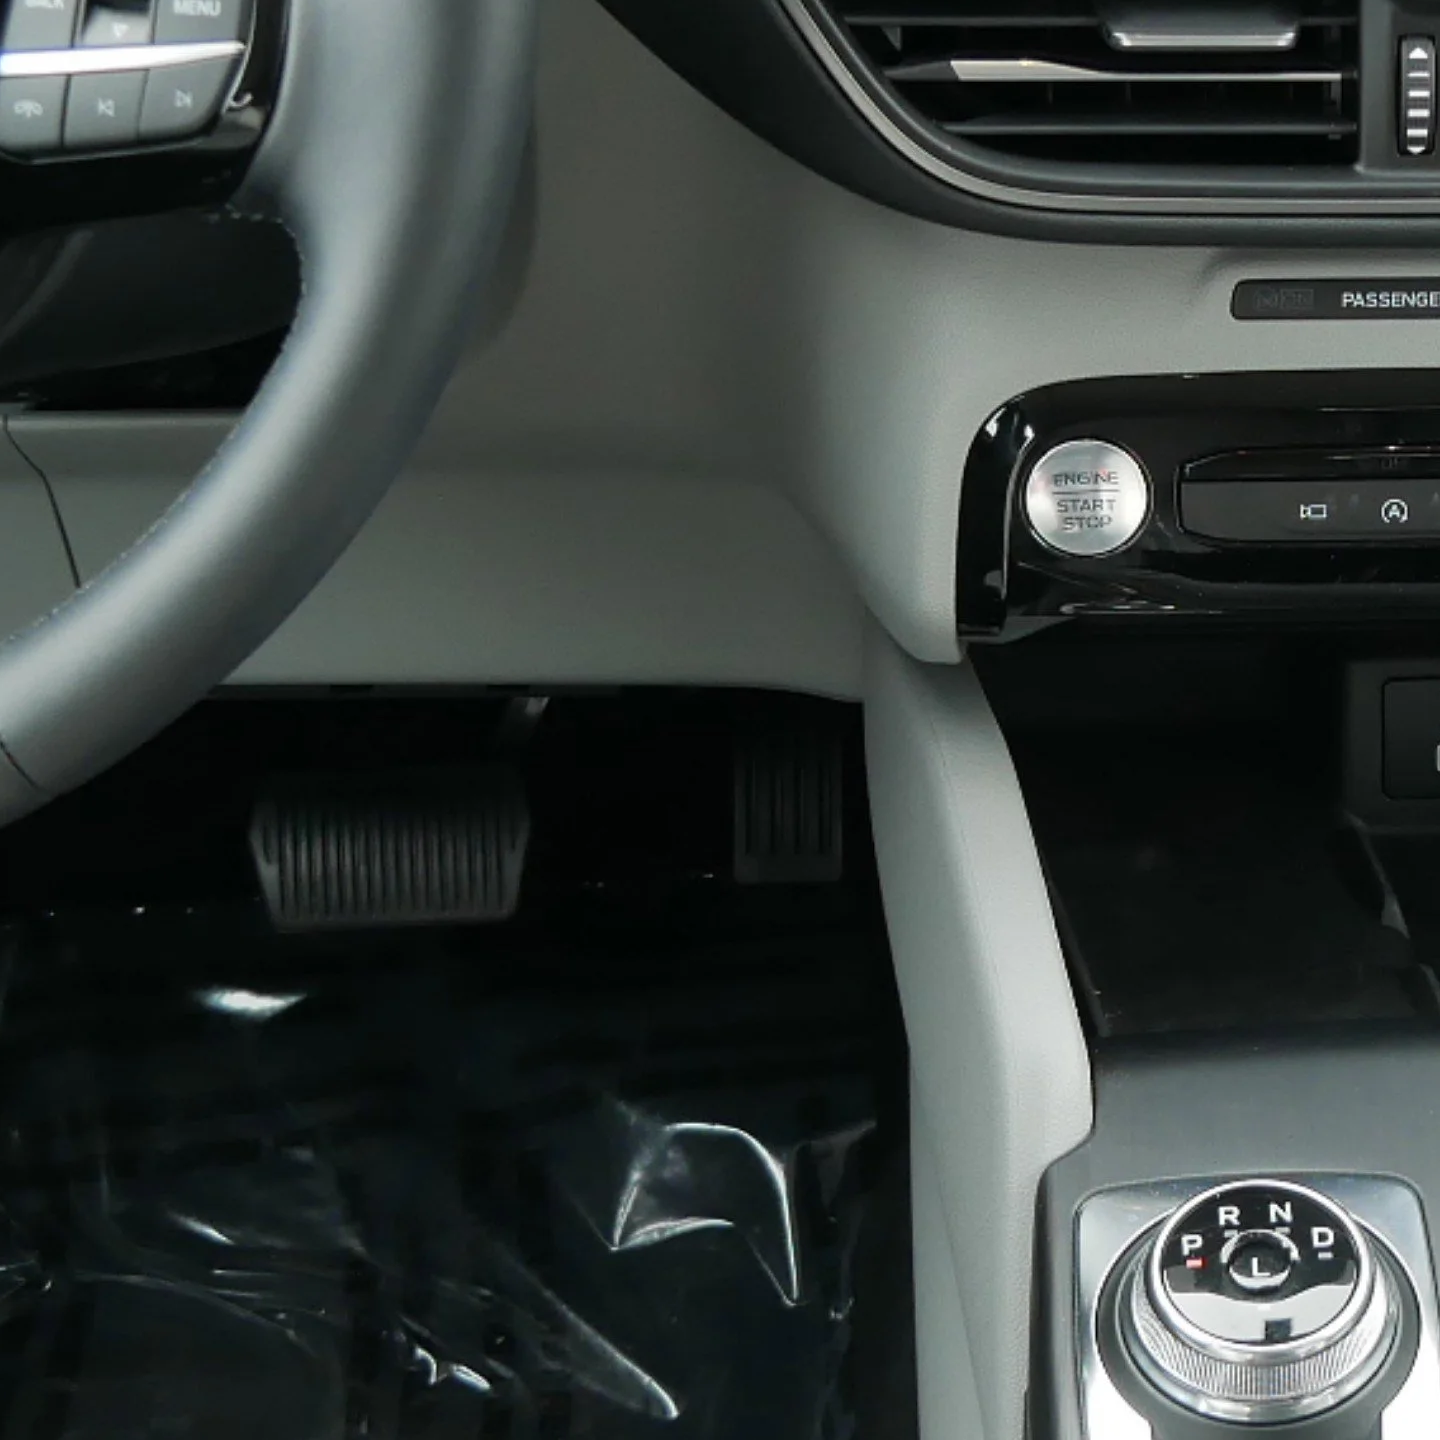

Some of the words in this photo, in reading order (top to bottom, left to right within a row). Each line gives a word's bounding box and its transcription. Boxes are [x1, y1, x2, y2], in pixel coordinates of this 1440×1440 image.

[1052, 470, 1120, 488] ENGINE
[1056, 498, 1117, 514] START
[1061, 514, 1114, 531] STOP
[1180, 1233, 1203, 1257] P
[1217, 1205, 1241, 1227] R
[1269, 1201, 1294, 1224] N
[1310, 1226, 1335, 1249] D
[1251, 1256, 1271, 1278] L
